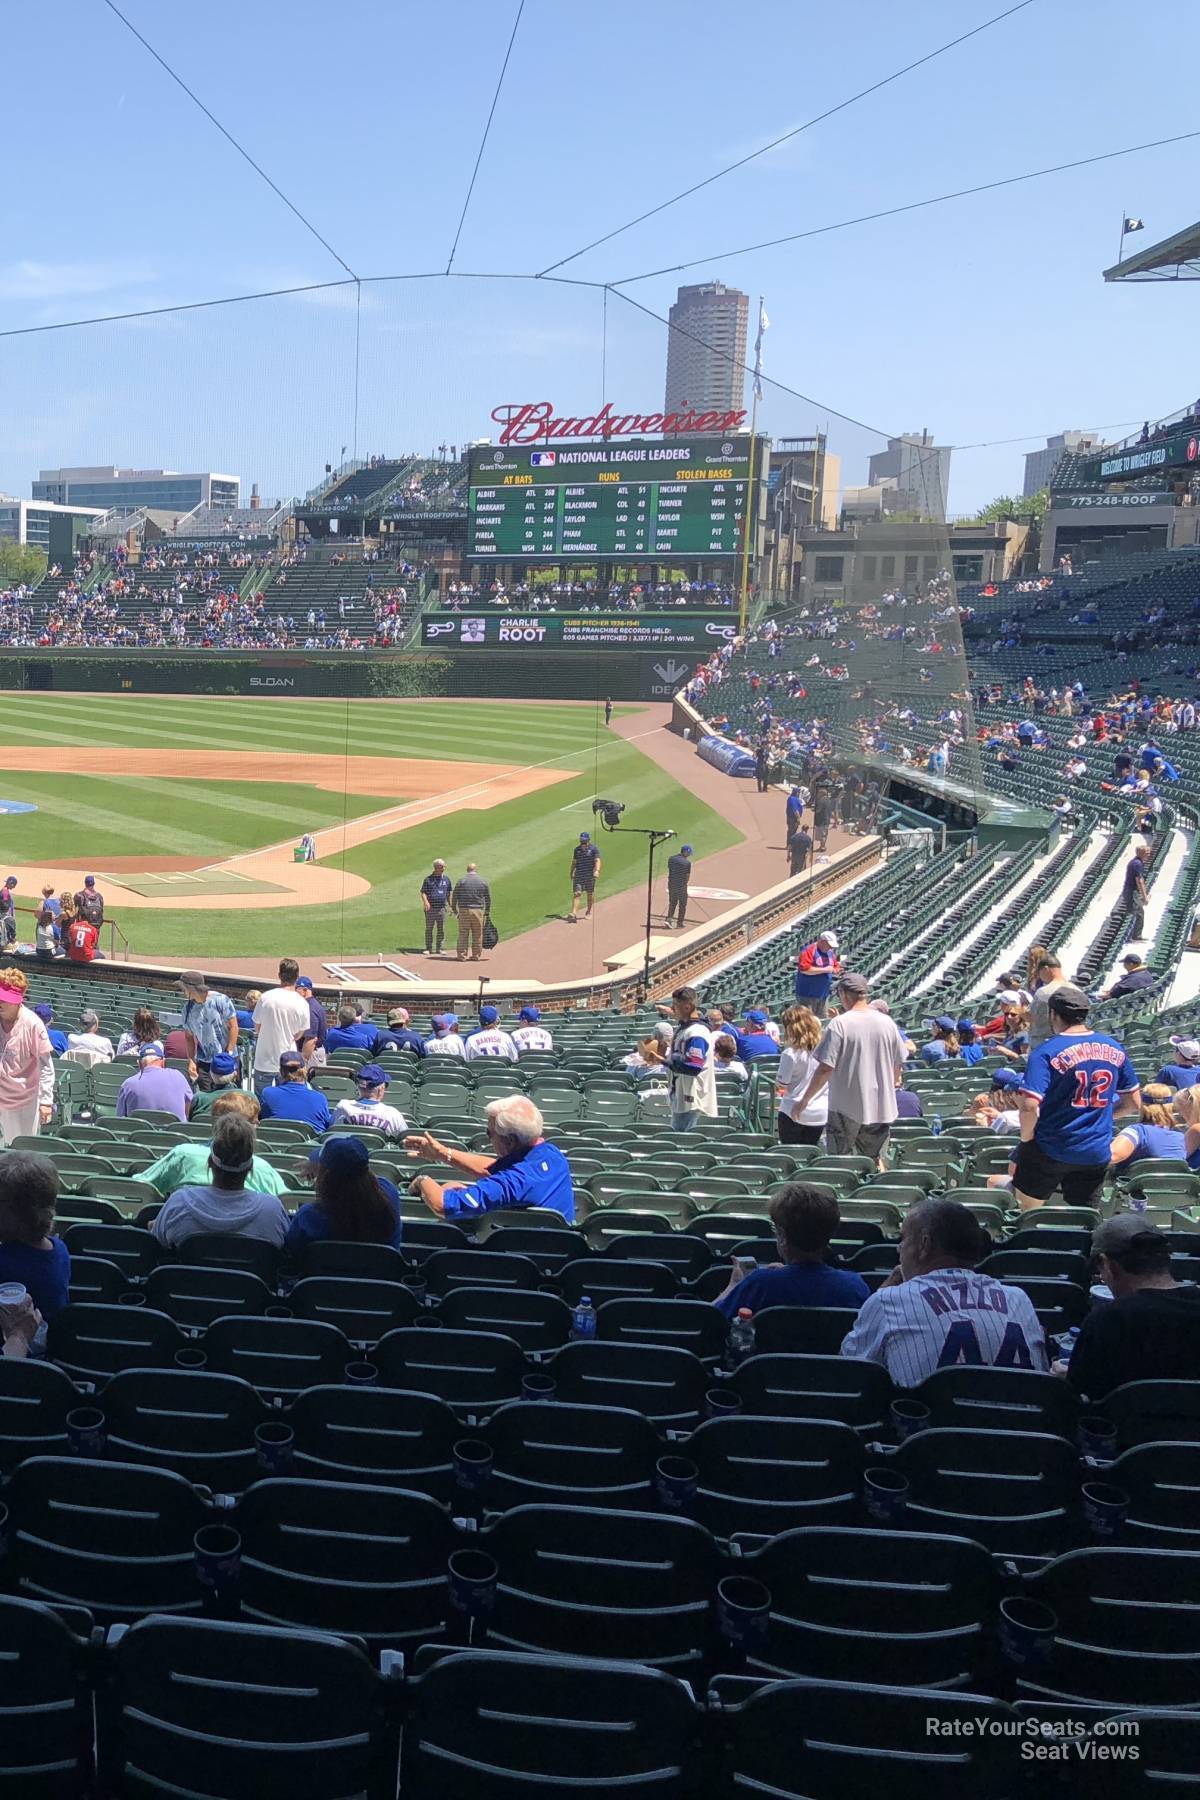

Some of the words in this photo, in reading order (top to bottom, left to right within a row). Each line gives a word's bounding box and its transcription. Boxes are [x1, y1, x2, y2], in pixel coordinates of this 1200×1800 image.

[491, 402, 747, 444] Budweiser
[559, 452, 608, 464] NATIONAL
[610, 450, 646, 462] LEAGUE
[648, 448, 690, 460] LEADERS
[598, 472, 620, 482] RUNS
[676, 470, 706, 480] STOLEN
[708, 469, 733, 478] BASES
[503, 476, 514, 485] AT
[515, 475, 533, 484] BATS
[526, 489, 536, 497] ATL
[565, 488, 585, 496] ALBIES
[618, 487, 628, 495] ATL
[658, 499, 682, 507] TURNER
[1071, 495, 1156, 506] 773-248-ROOF
[564, 515, 586, 523] TAYLOR
[658, 513, 680, 521] TAYLOR
[616, 529, 626, 537] STL
[711, 528, 722, 536] PIT
[499, 618, 539, 627] CHARLIE
[498, 628, 546, 641] ROOT
[249, 677, 294, 686] SLOAN
[75, 930, 86, 948] 8
[1050, 1042, 1125, 1075] SCHWARBER
[1071, 1069, 1113, 1108] 12
[920, 1280, 1008, 1317] RIZZO
